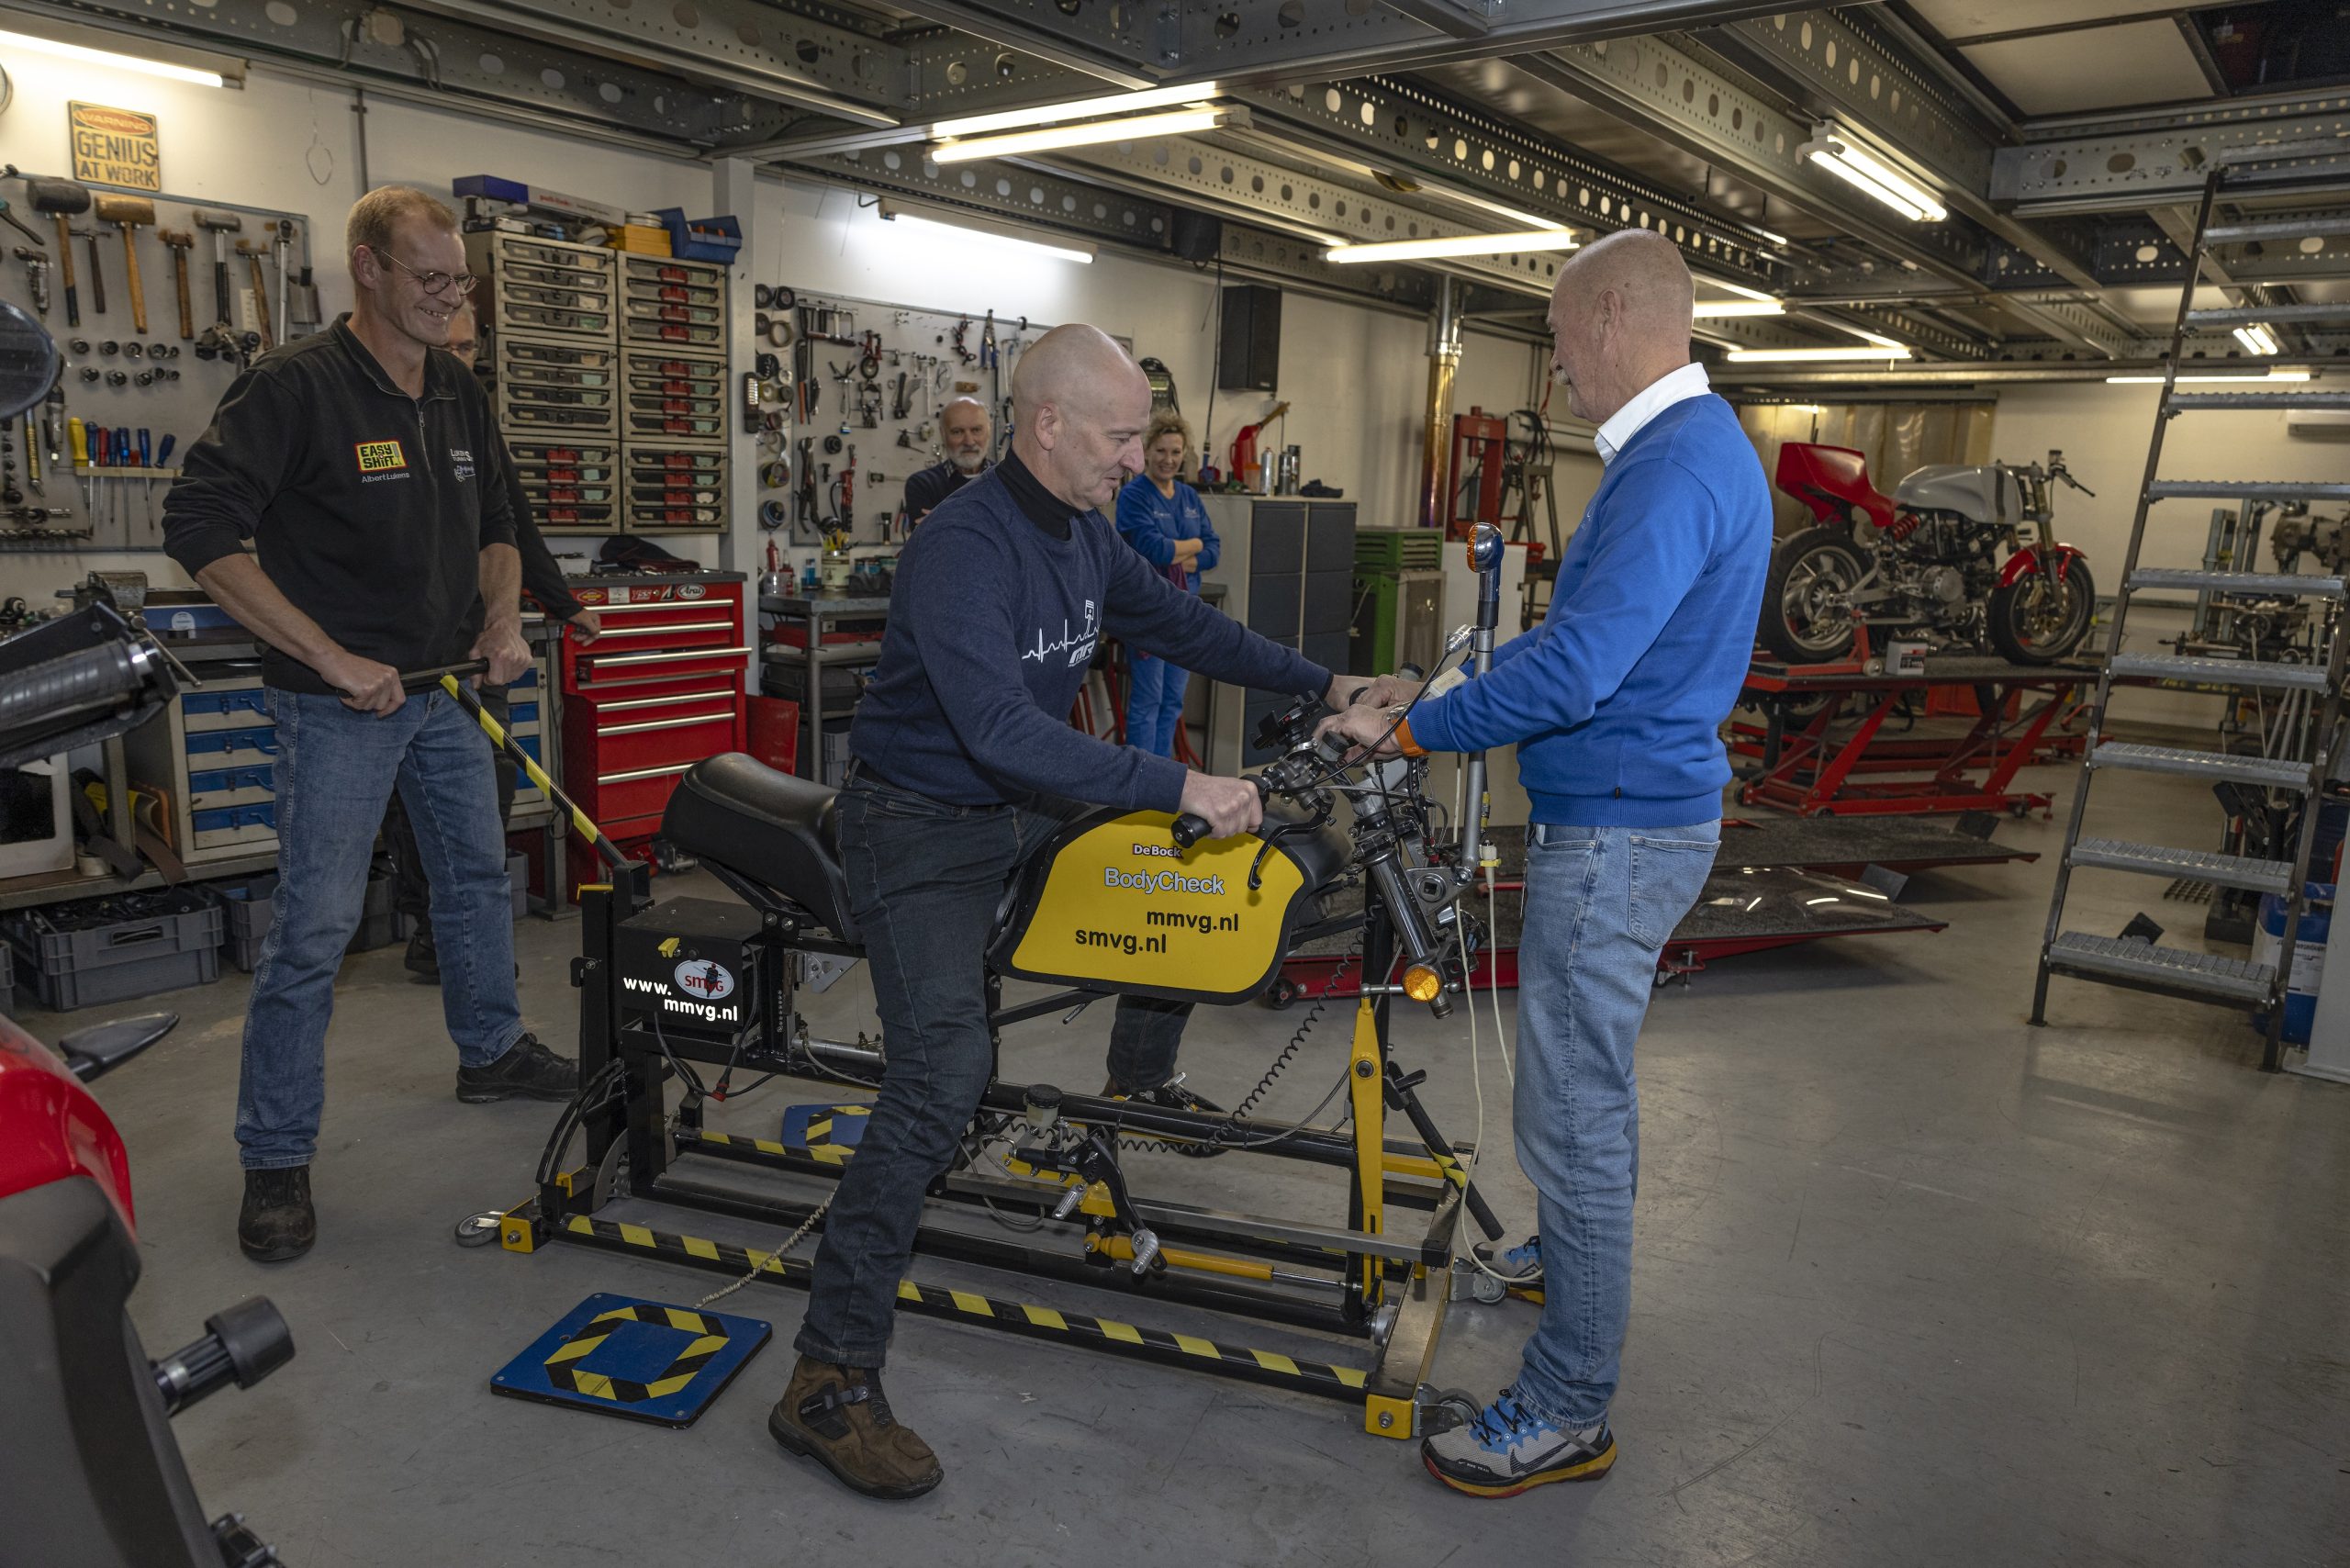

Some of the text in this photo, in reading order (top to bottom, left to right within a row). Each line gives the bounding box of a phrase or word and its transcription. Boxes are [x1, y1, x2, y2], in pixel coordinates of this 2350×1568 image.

[77, 130, 157, 167] GENIUS
[80, 160, 157, 187] AT WORK
[360, 444, 393, 458] EASY
[362, 473, 386, 484] Albert
[682, 585, 702, 595] Arai
[1104, 867, 1225, 896] BodyCheck
[1147, 911, 1239, 935] mmvg.nl
[1075, 929, 1167, 956] smvg.nl
[623, 977, 672, 996] www.
[664, 998, 738, 1022] mmvg.nl
